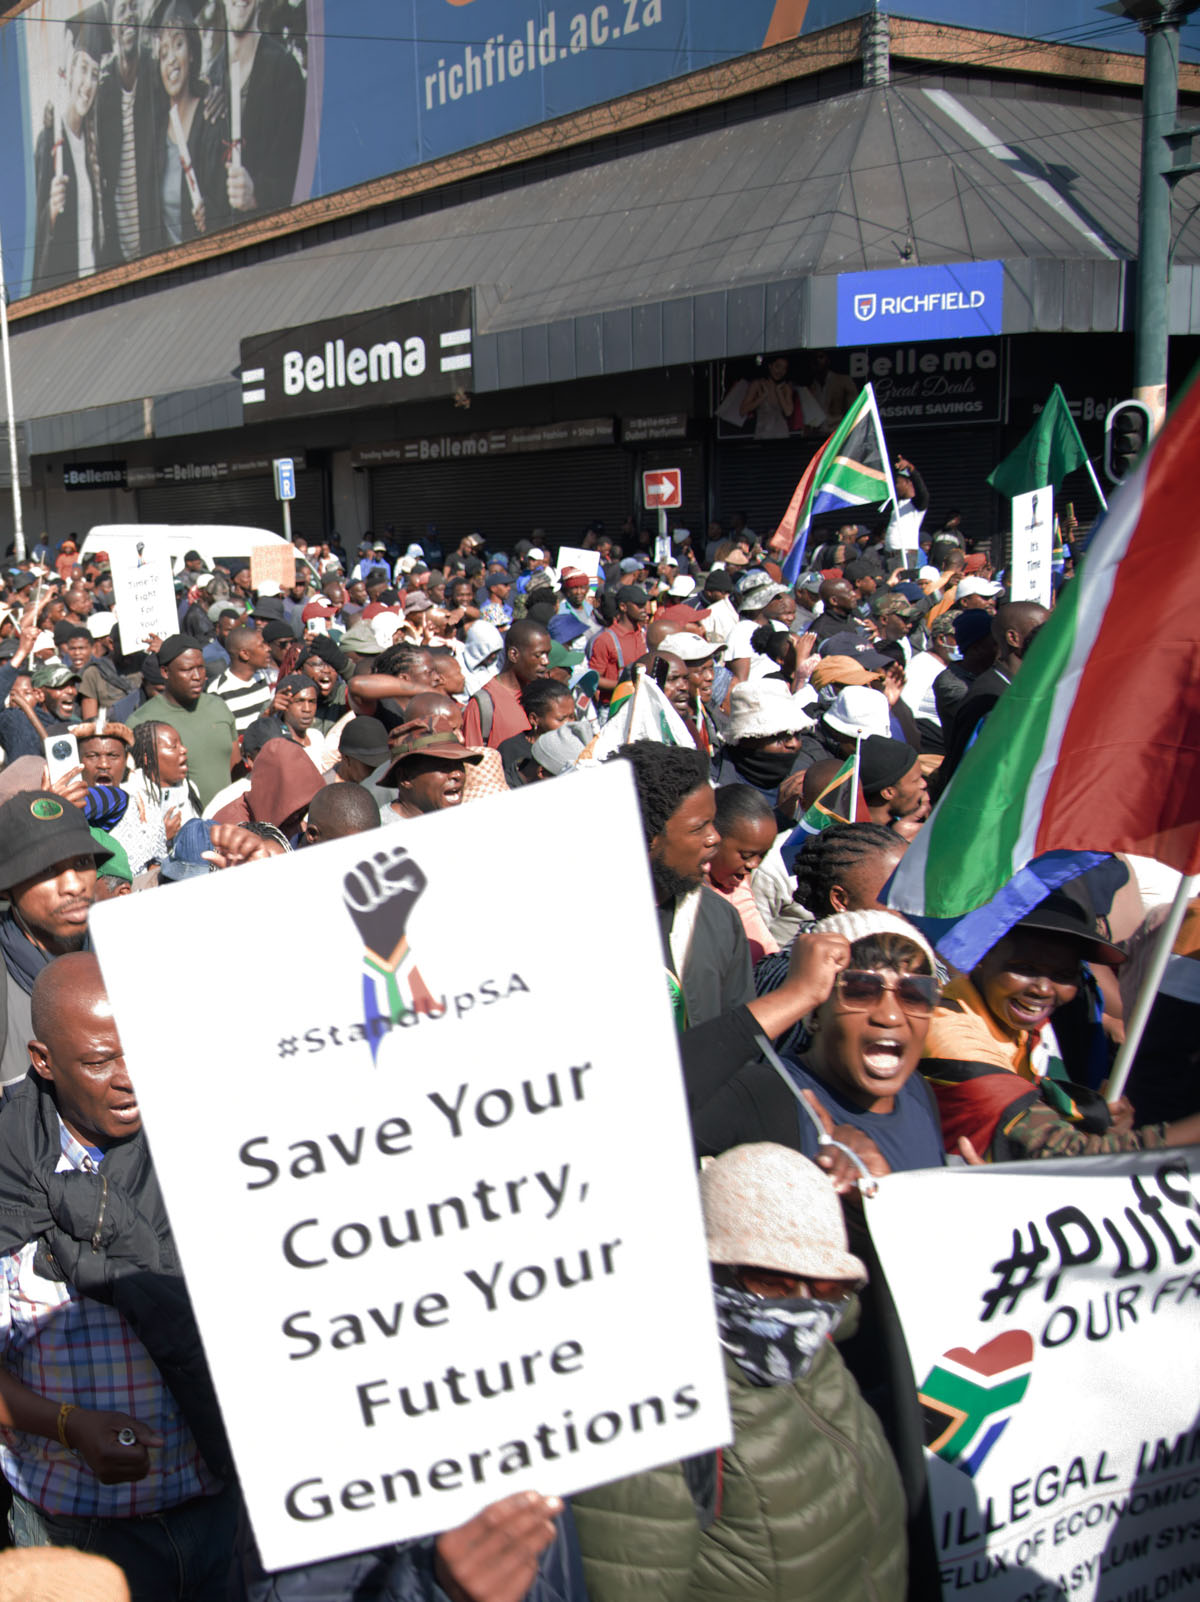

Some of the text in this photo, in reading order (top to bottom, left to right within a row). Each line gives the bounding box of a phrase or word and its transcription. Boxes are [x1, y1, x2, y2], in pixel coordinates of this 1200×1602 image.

[425, 0, 662, 110] richfield.ac.za
[880, 290, 985, 315] RICHFIELD
[282, 335, 427, 396] Bellema
[849, 348, 997, 377] Bellema
[920, 374, 977, 398] Deals
[925, 400, 983, 415] SAVINGS
[69, 468, 121, 484] Bellema
[173, 463, 218, 480] Bellema
[419, 439, 488, 460] Bellema
[278, 973, 531, 1060] #StandUpSA
[238, 1061, 593, 1190] Save Your
[281, 1163, 590, 1271] Country,
[281, 1238, 623, 1361] Save Your
[1040, 1285, 1143, 1349] OUR
[355, 1338, 586, 1428] Future
[284, 1383, 702, 1525] Generations
[942, 1450, 1119, 1551] ILLEGAL
[1015, 1528, 1046, 1567] OF
[1053, 1476, 1200, 1546] ECONOMIC
[1057, 1534, 1151, 1596] ASYLUM
